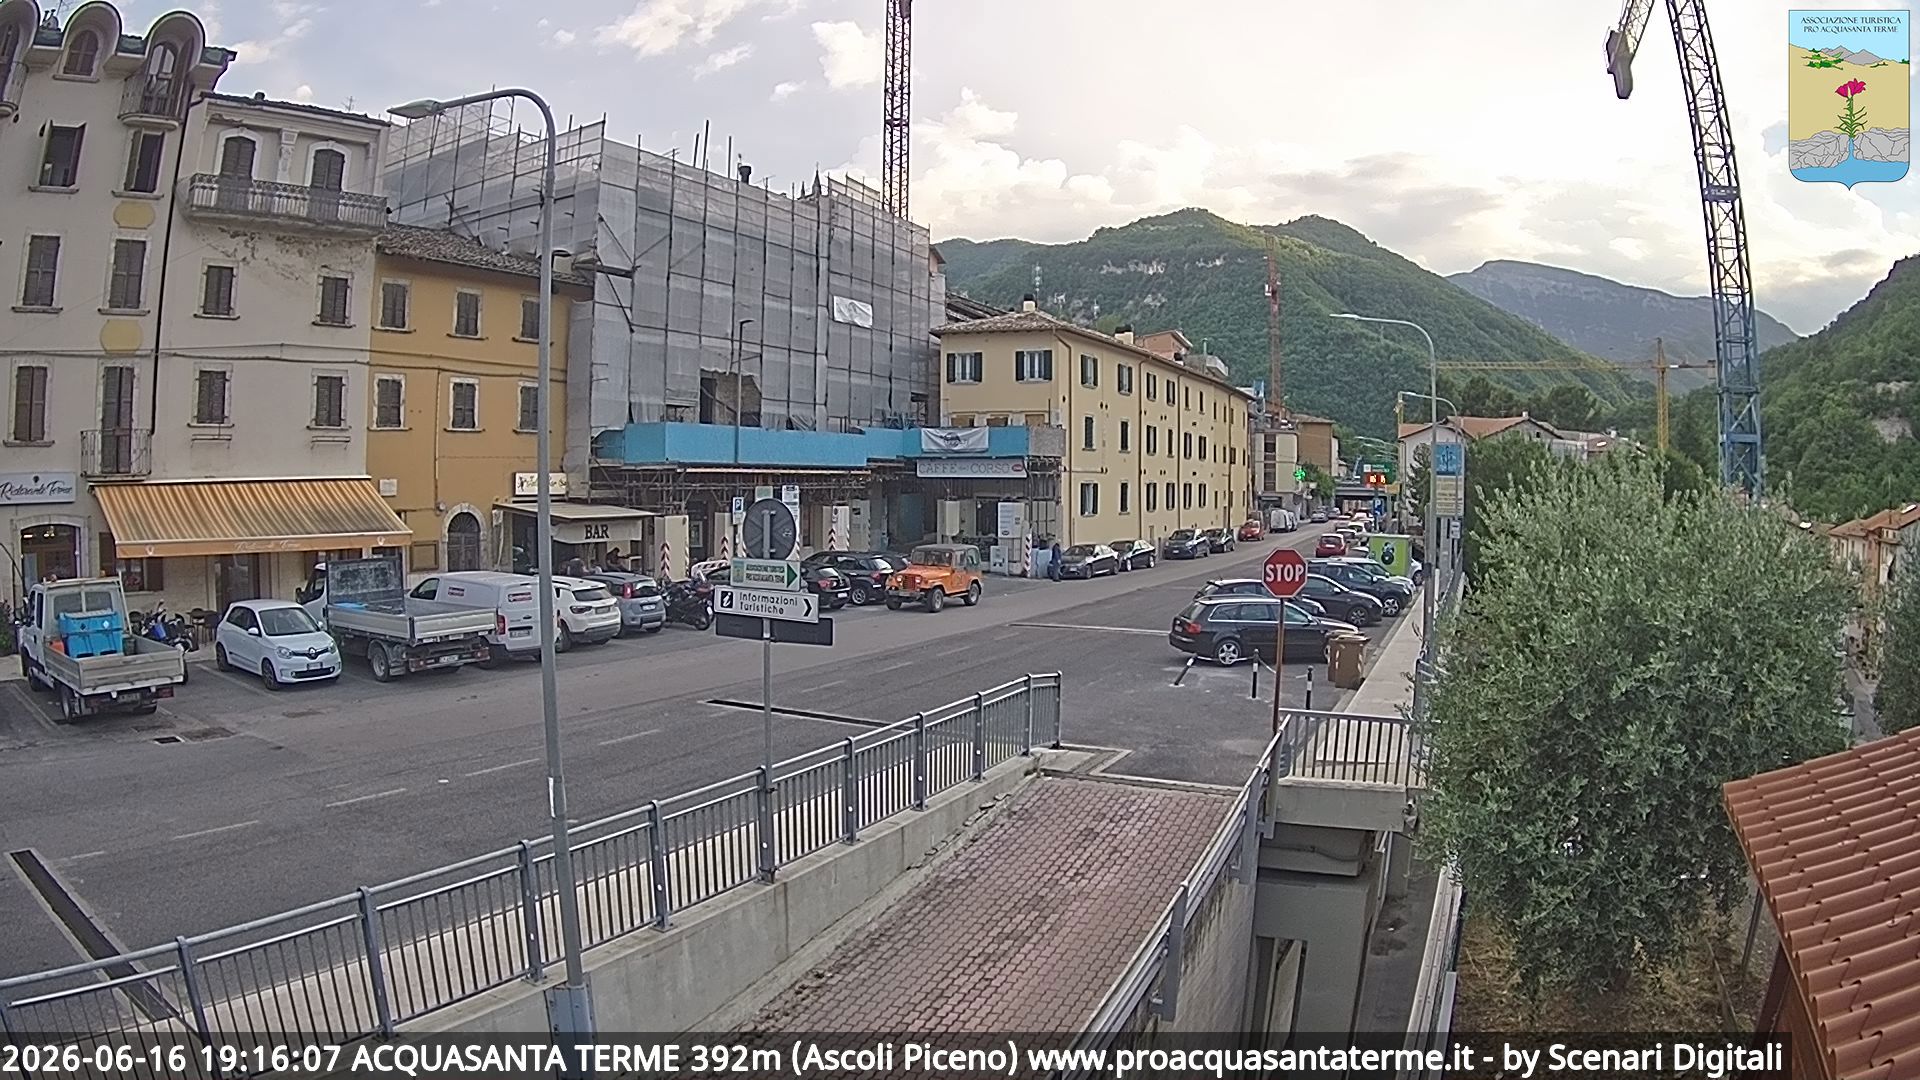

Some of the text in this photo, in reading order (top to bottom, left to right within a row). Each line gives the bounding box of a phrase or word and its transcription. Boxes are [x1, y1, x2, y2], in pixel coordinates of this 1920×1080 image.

[970, 463, 1010, 474] CORSO
[584, 523, 610, 540] BAR
[1265, 563, 1305, 582] STOP
